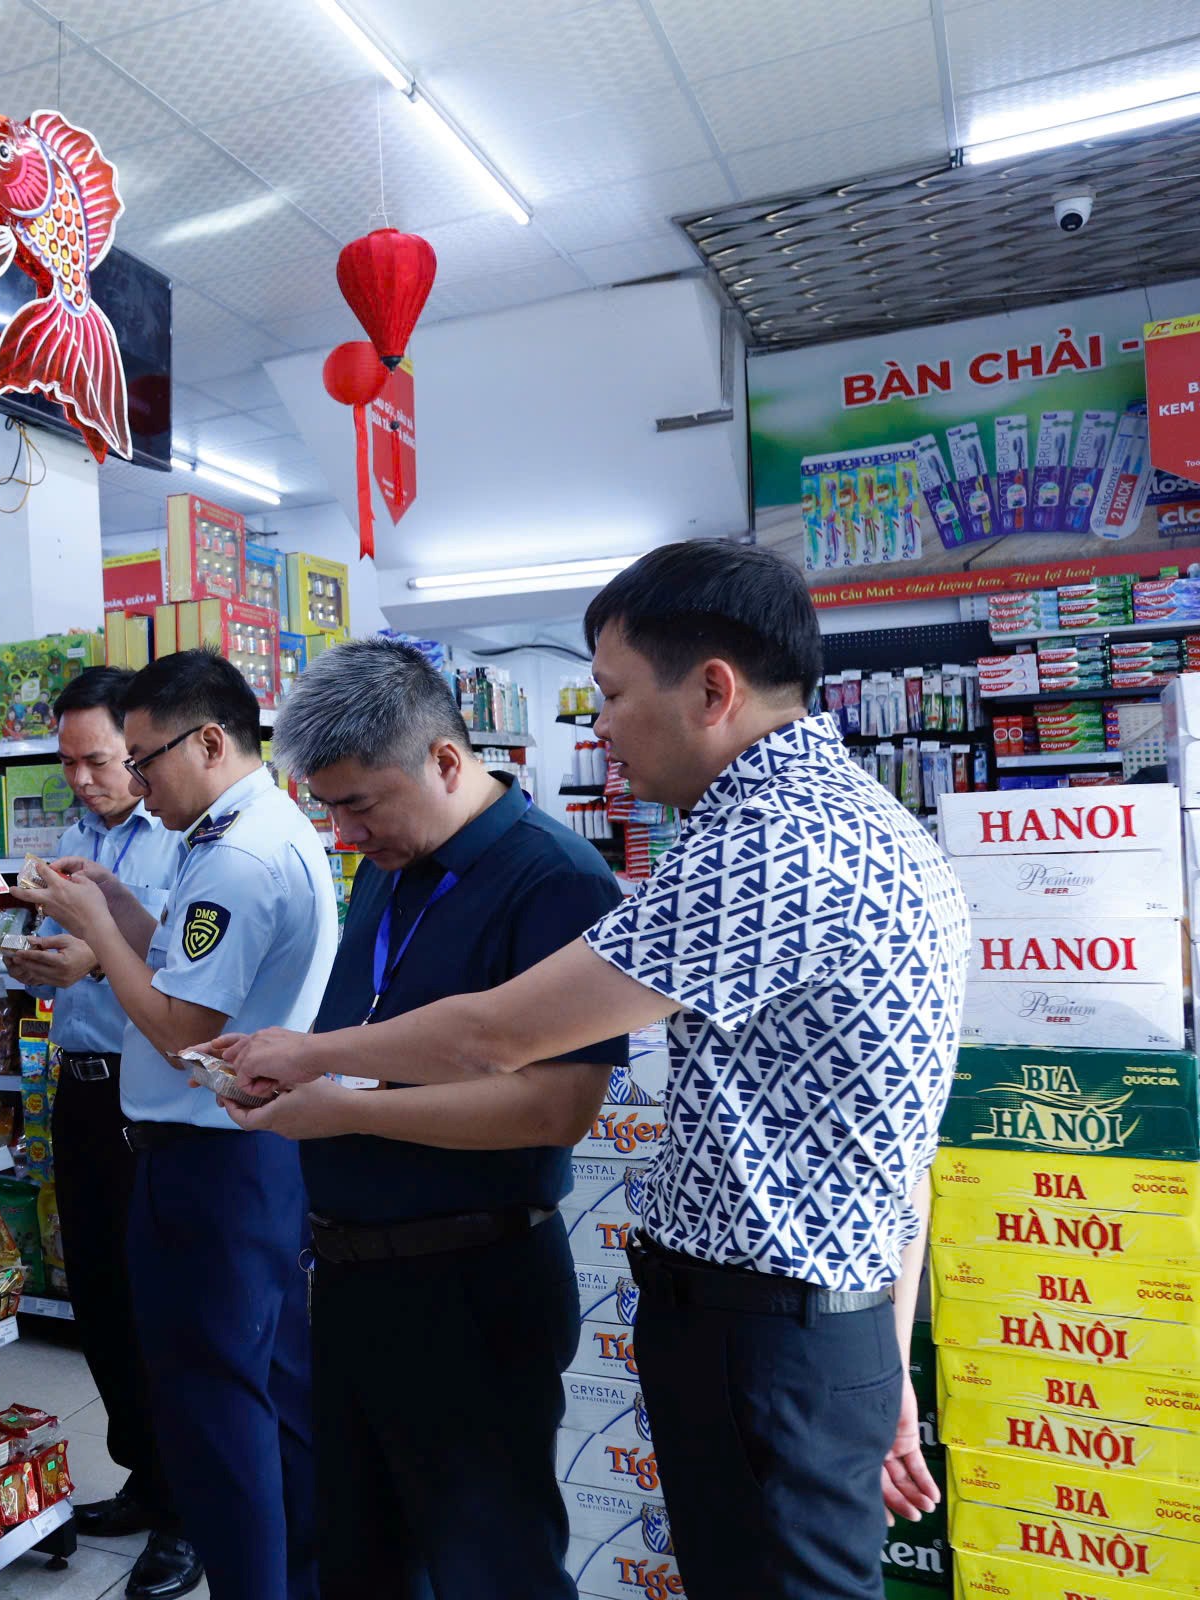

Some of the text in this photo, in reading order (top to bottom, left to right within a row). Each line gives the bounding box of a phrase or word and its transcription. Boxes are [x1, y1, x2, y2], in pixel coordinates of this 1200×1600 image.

[843, 361, 952, 407] BÀN
[968, 328, 1103, 386] CHẢI
[1159, 401, 1195, 416] KEM
[1099, 466, 1121, 515] SENSODYNE
[1115, 480, 1134, 508] PACK
[840, 587, 864, 600] Cầu
[867, 585, 895, 599] Mart
[905, 581, 935, 594] Chất
[938, 579, 972, 597] lượng
[1011, 571, 1040, 585] Tiện
[1044, 568, 1061, 584] lợi
[1059, 590, 1087, 598] Colgate
[1060, 603, 1088, 611] Colgate
[1061, 618, 1089, 626] Colgate
[1038, 715, 1067, 723] Colgate
[1039, 728, 1070, 736] Colgate
[1041, 741, 1071, 749] Colgate
[978, 804, 1137, 843] HANOI
[1016, 863, 1095, 890] Premium
[1044, 887, 1069, 895] BEER
[195, 908, 218, 923] DMS
[979, 937, 1137, 971] HANOI
[1018, 990, 1097, 1017] Premium
[1021, 1065, 1081, 1094] BIA
[1122, 1075, 1180, 1086] QUỐC GIA
[588, 1112, 666, 1153] Tiger
[990, 1101, 1125, 1150] HÀ NỘI
[572, 1164, 616, 1175] RYSTAL
[941, 1174, 980, 1184] HABECO
[1033, 1172, 1087, 1200] BIA
[1169, 1185, 1188, 1195] GIA
[995, 1207, 1124, 1257] HÀ NỘI
[945, 1274, 984, 1285] HABECO
[1037, 1274, 1092, 1304] BIA
[1173, 1292, 1194, 1302] GIA
[1000, 1312, 1129, 1364] HÀ NỘI
[952, 1375, 992, 1386] HABECO
[570, 1383, 626, 1400] CRYSTAL
[1044, 1378, 1099, 1410] BIA
[1182, 1400, 1200, 1411] GIA
[1006, 1415, 1136, 1470] HÀ NỘI
[961, 1478, 1000, 1490] HABECO
[576, 1491, 632, 1510] CRYSTAL
[1054, 1484, 1109, 1518] BIA
[1019, 1521, 1150, 1578] HÀ NỘI
[970, 1581, 1010, 1595] HABECO
